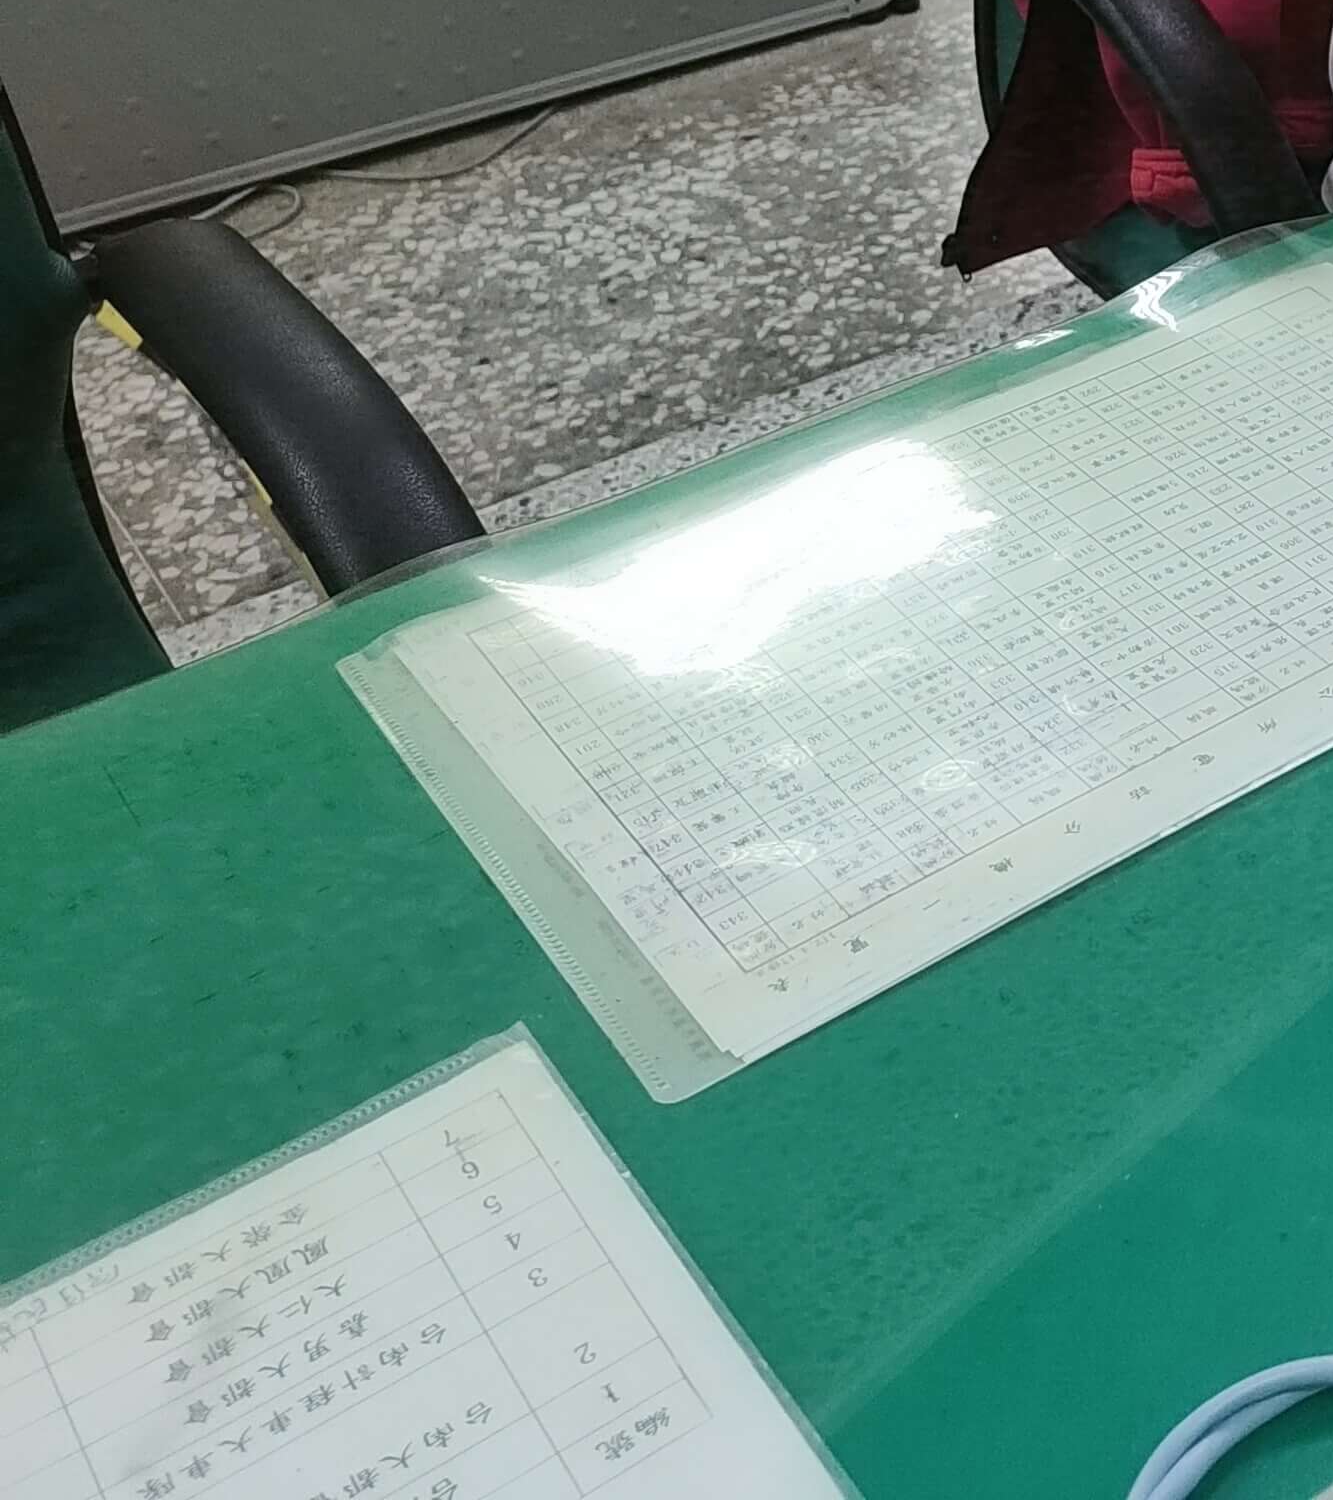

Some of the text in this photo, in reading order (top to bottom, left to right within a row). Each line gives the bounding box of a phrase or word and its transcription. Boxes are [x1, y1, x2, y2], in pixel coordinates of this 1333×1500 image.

[139, 1232, 333, 1349] 鳳凰大都會
[157, 1272, 350, 1388] 大仁大都會
[135, 1319, 449, 1500] 台南計程車大車隊
[177, 1309, 372, 1429] 嘉男大都會
[593, 1406, 674, 1464] 編號
